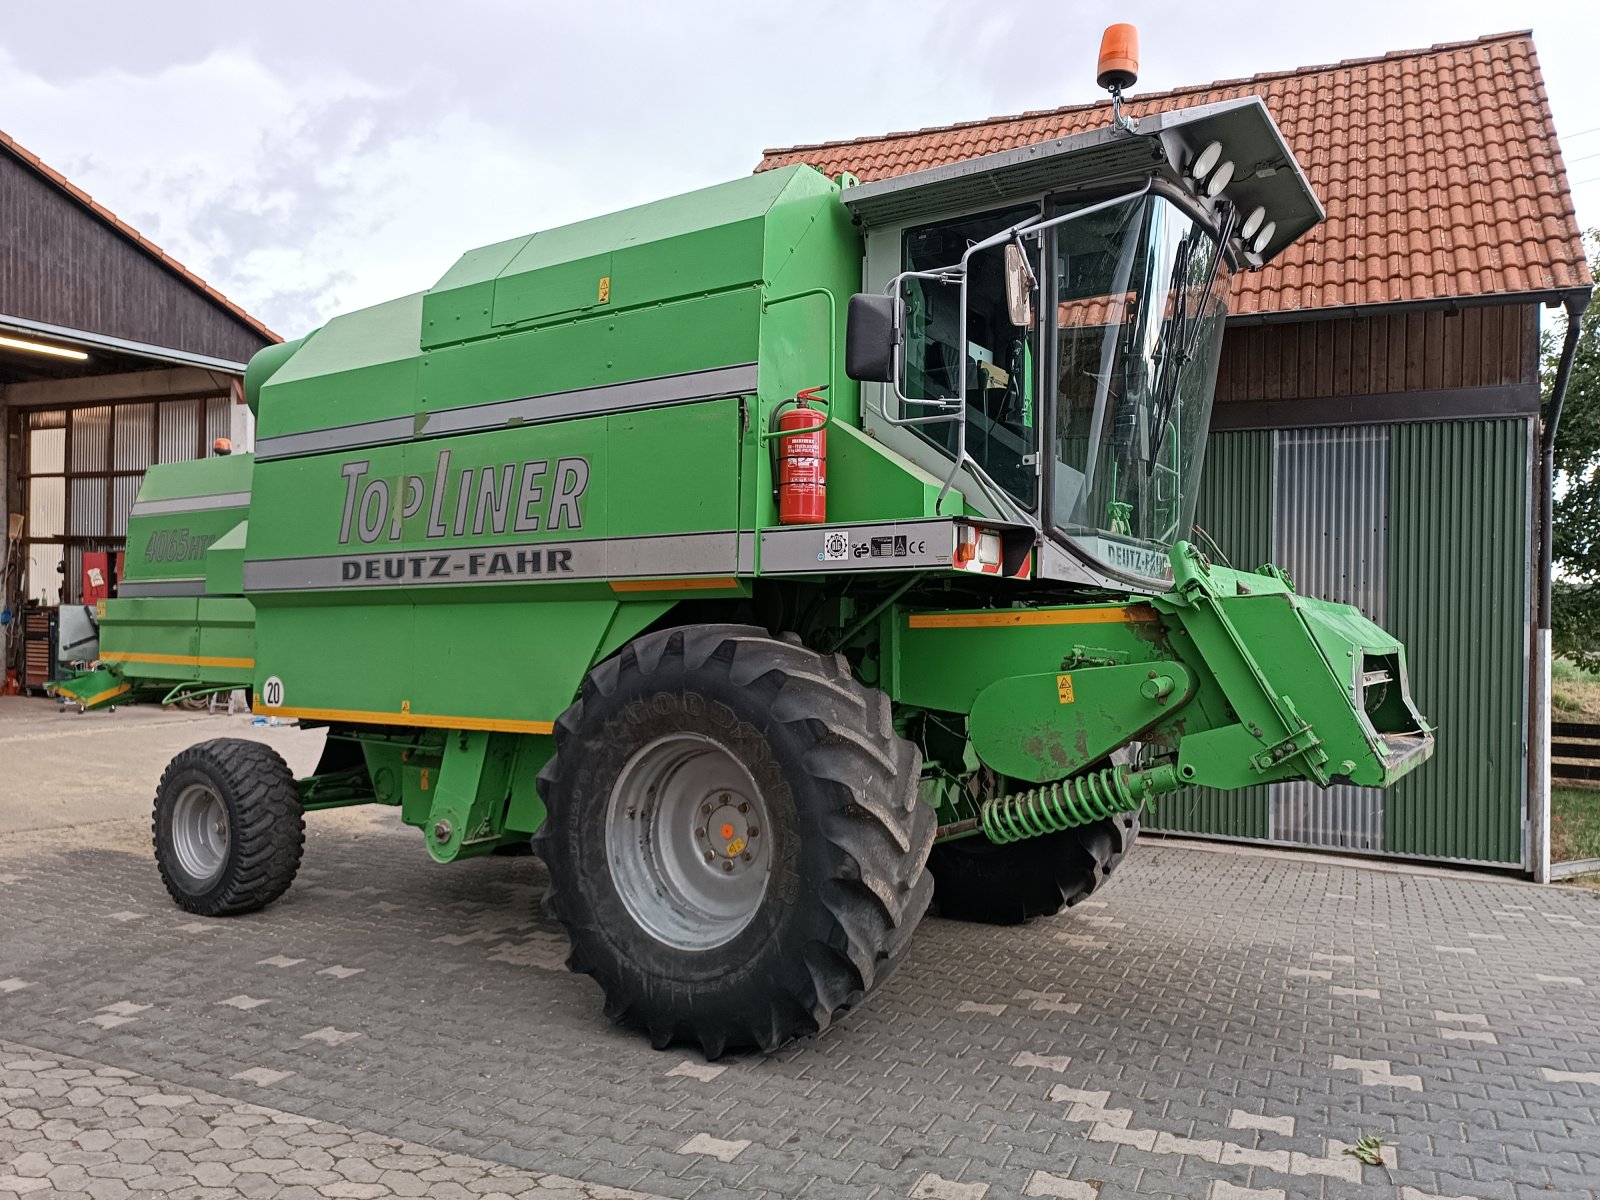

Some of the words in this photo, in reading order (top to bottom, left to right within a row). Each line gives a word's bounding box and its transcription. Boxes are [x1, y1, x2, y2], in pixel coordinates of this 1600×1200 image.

[909, 540, 925, 554] CE
[342, 548, 574, 582] DEUTZ-FAHR
[267, 682, 280, 704] 20
